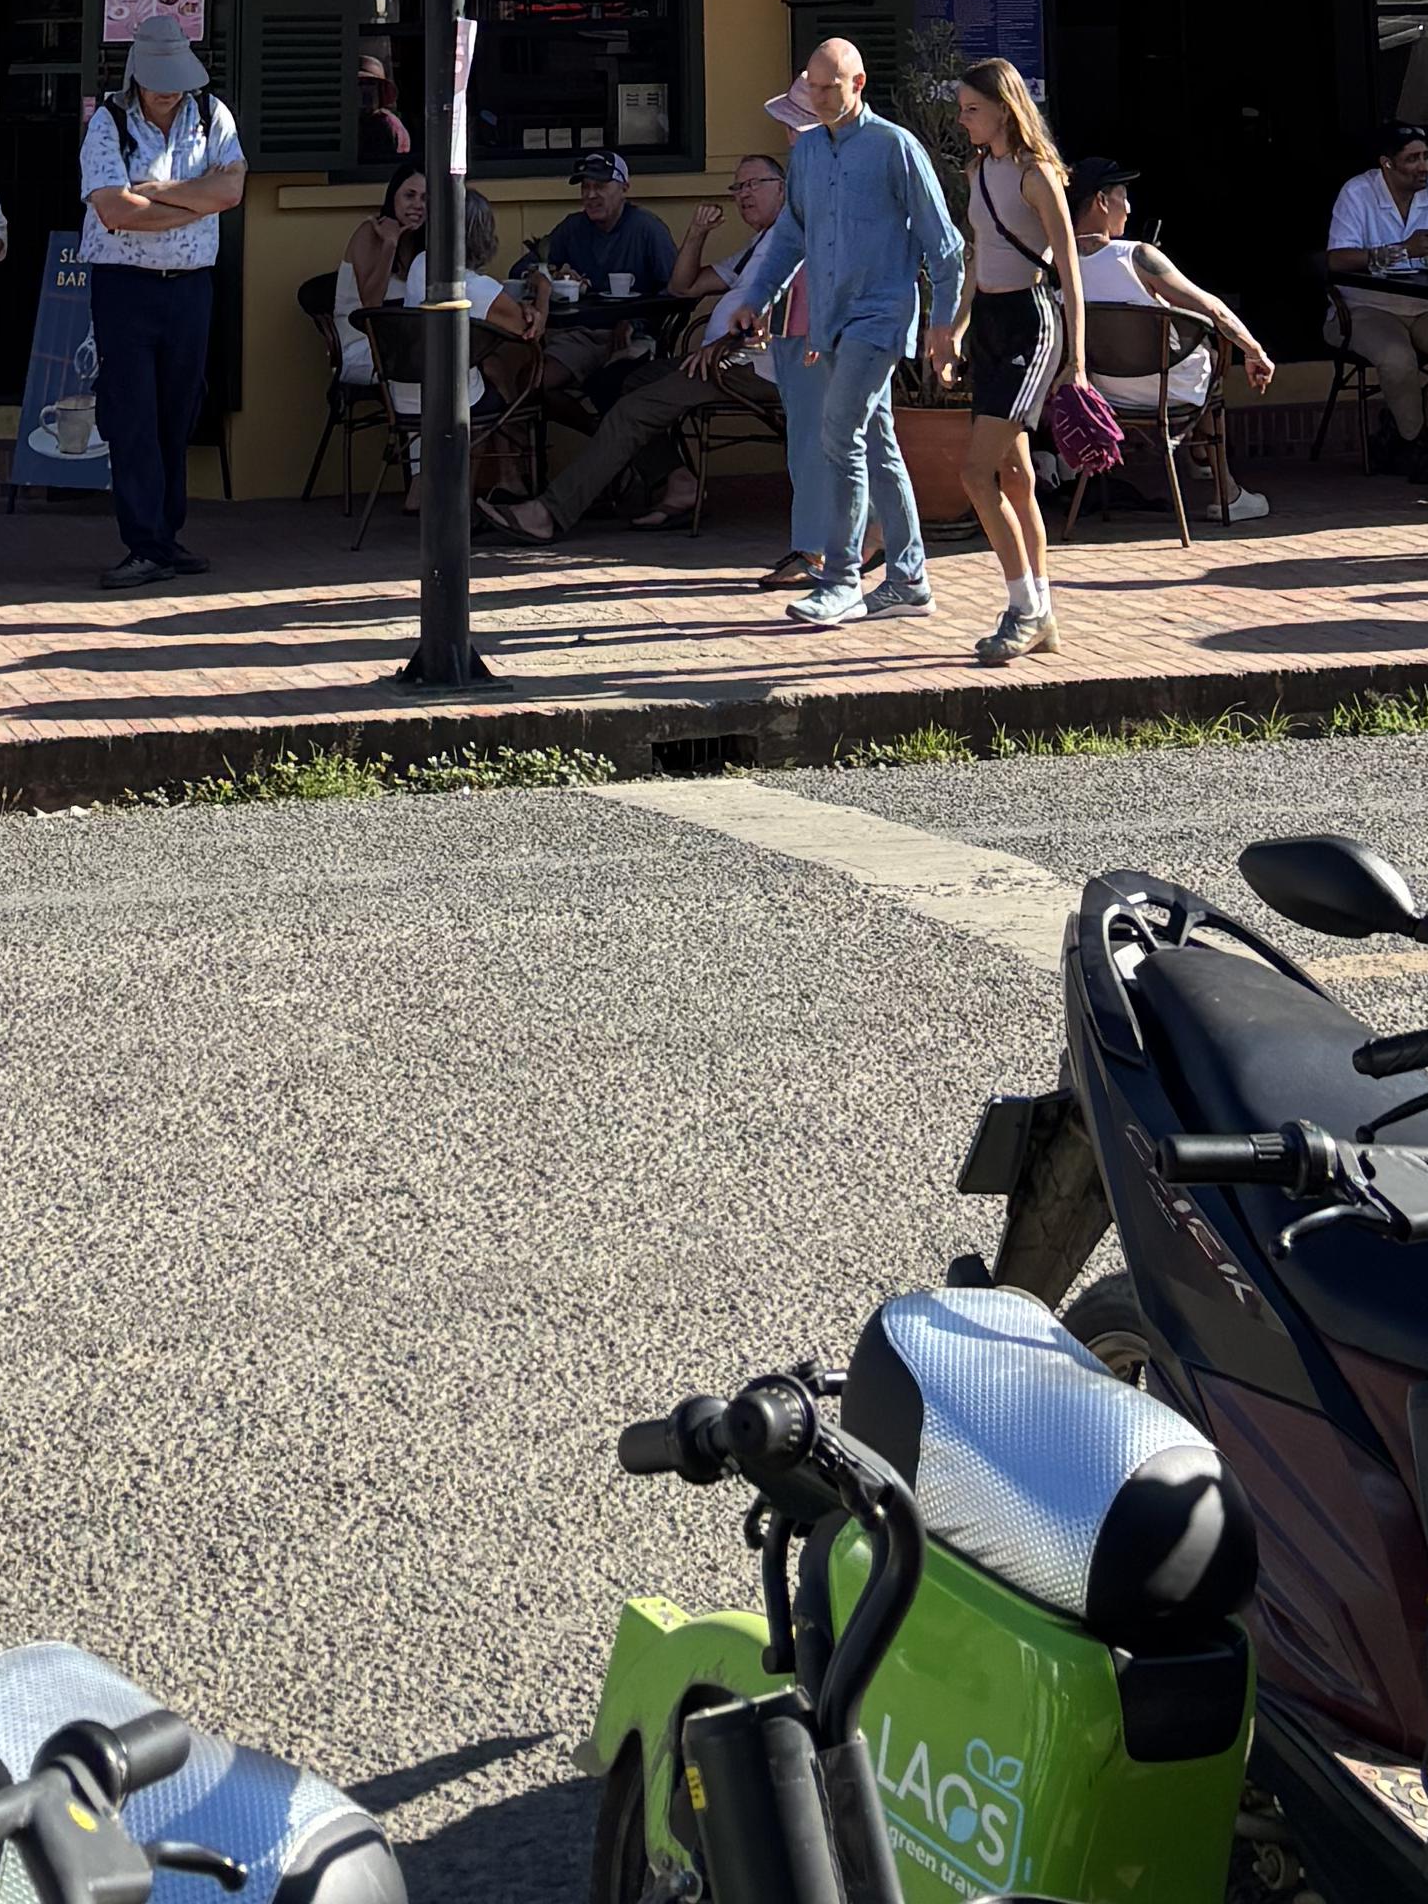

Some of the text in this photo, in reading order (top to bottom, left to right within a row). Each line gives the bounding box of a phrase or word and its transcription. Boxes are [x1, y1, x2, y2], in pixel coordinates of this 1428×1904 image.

[57, 271, 87, 287] BAR
[876, 1713, 1009, 1867] LAOS
[888, 1826, 937, 1873] green
